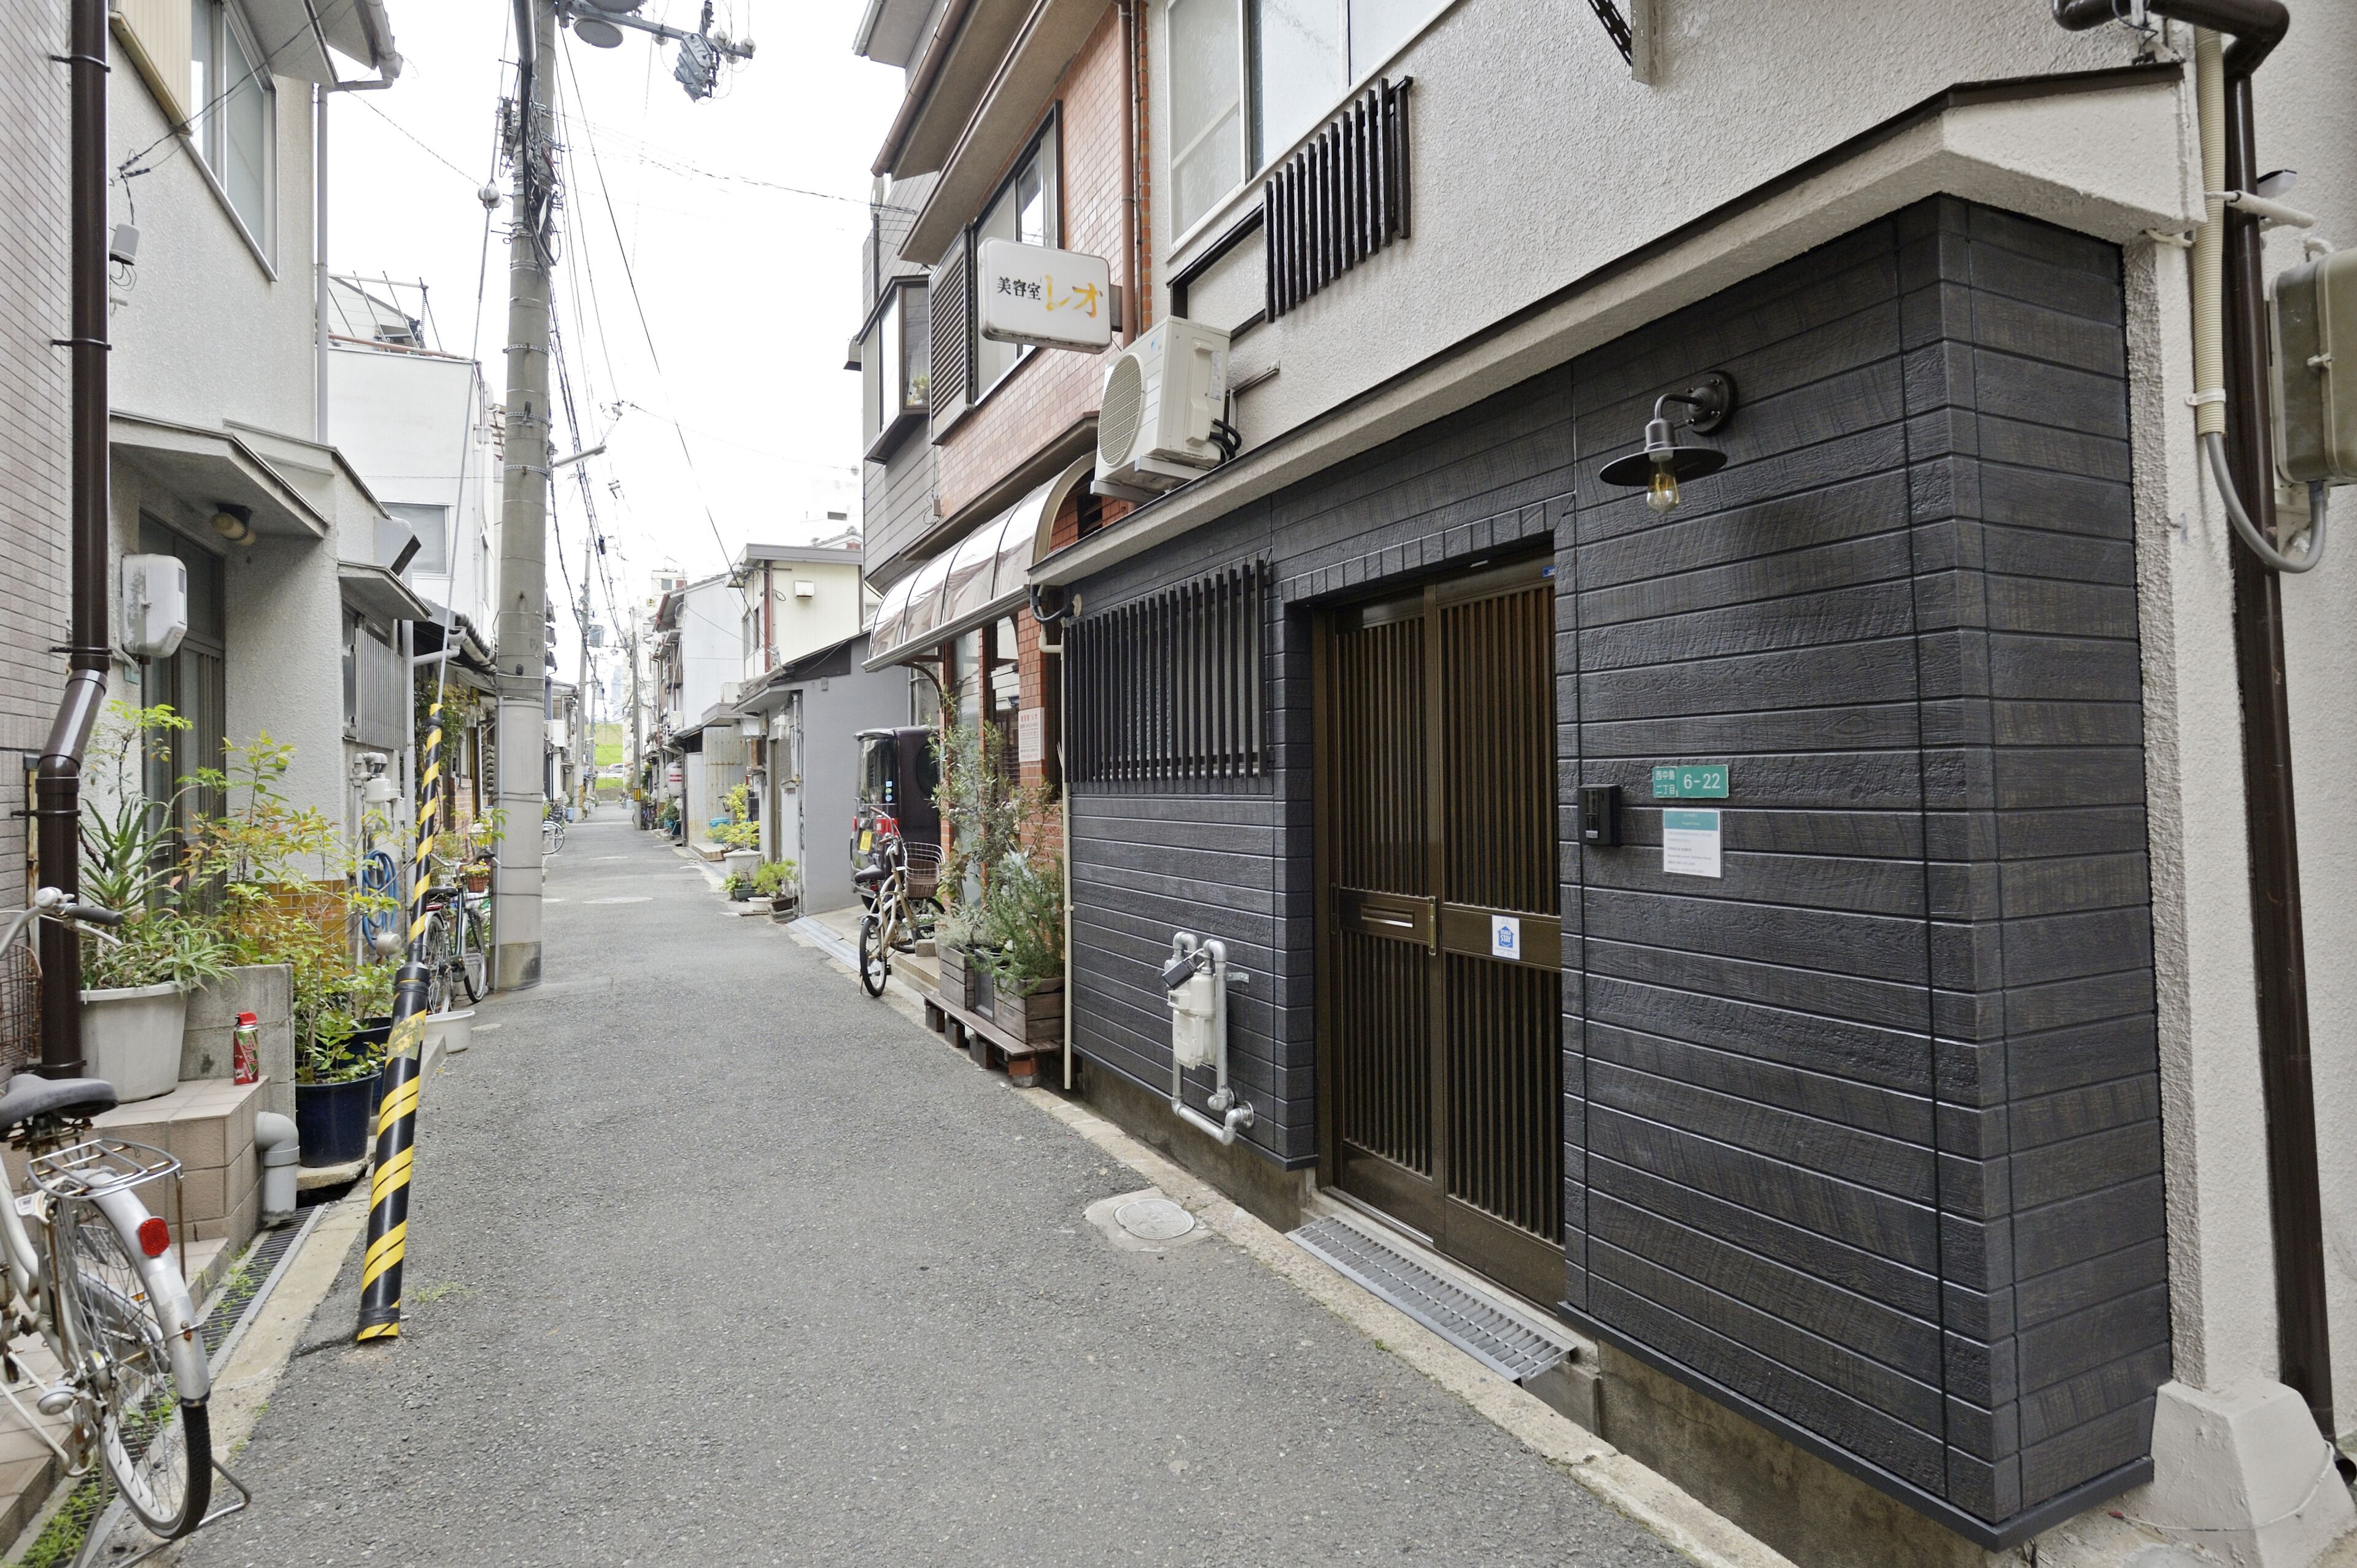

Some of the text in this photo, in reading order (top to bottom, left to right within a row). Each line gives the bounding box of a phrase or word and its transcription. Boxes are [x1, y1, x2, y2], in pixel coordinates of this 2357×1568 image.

[997, 274, 1103, 318] 美容室 レオ
[1684, 773, 1720, 789] 6-22
[1656, 784, 1675, 795] 二丁目
